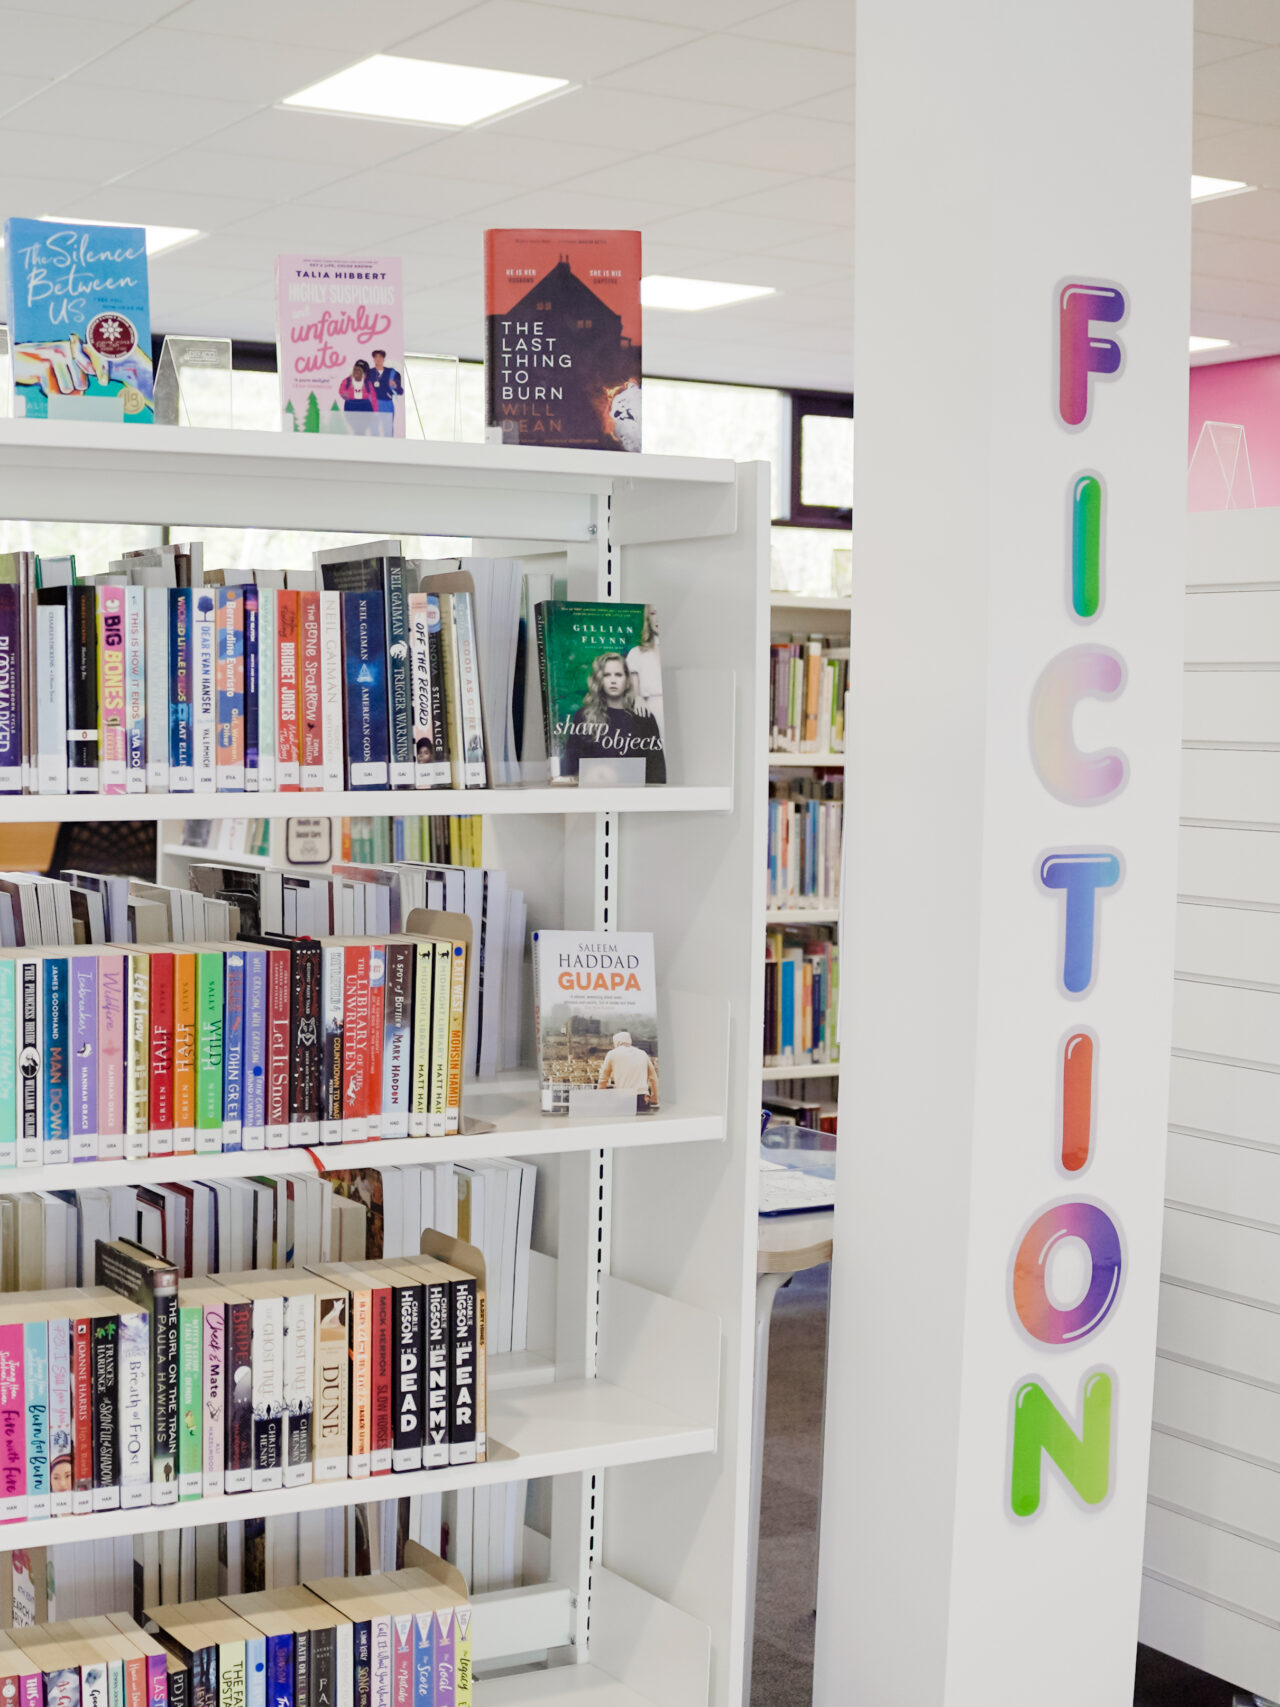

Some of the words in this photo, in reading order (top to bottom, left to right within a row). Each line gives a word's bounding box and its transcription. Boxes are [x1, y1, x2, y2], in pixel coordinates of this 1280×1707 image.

[18, 241, 51, 269] The
[46, 231, 144, 268] Silence
[26, 264, 138, 307] Between
[296, 270, 330, 279] TALIA
[335, 272, 386, 280] HIBBERT
[288, 283, 328, 303] HIGHLY
[329, 284, 394, 304] SUSPICIOUS
[290, 305, 391, 344] unfairly
[501, 322, 543, 335] THE
[294, 341, 346, 373] cute
[501, 354, 572, 368] THING
[502, 338, 557, 351] LAST
[501, 370, 528, 384] TO
[502, 386, 563, 400] BURN
[501, 403, 555, 417] WILL
[502, 420, 562, 433] DEAN
[391, 568, 402, 590] NEIL
[359, 600, 367, 621] NEIL
[392, 592, 403, 635] GAIMAN
[105, 615, 121, 646] BIG
[201, 626, 210, 648] DEAR
[226, 601, 236, 655] Bernardine
[360, 623, 368, 660] GAIMAN
[415, 623, 427, 645] OFF
[573, 624, 634, 634] GILLIAN
[581, 636, 626, 645] FLYNN
[202, 653, 210, 675] EVAN
[226, 658, 235, 697] Evaristo
[281, 642, 295, 684] BRIDGET
[417, 650, 428, 675] THE
[105, 650, 123, 709] BONES
[202, 678, 211, 714] HANSEN
[395, 667, 406, 710] TRIGGER
[281, 687, 296, 720] JONES
[361, 687, 370, 735] AMERICAN
[418, 678, 429, 726] RECORD
[396, 713, 409, 761] WARNING
[553, 715, 609, 743] sharp
[601, 729, 663, 755] objects
[363, 737, 371, 761] GODS
[1011, 282, 1125, 1518] FICTION
[559, 954, 640, 969] HADDAD
[578, 943, 618, 953] SALEEM
[557, 971, 641, 991] GUAPA
[345, 975, 356, 1072] UNWRITTEN
[356, 980, 367, 1050] LIBRARY
[272, 1019, 288, 1052] Let
[392, 1034, 403, 1061] MARK
[449, 1031, 460, 1070] MOHSIN
[272, 1056, 288, 1070] It
[271, 1074, 288, 1122] Snow
[391, 1066, 400, 1104] HADDON
[448, 1073, 459, 1106] HAMID
[168, 1299, 177, 1324] THE
[401, 1291, 414, 1344] HIGSON
[429, 1287, 441, 1340] HIGSON
[456, 1285, 467, 1337] HIGSON
[157, 1315, 167, 1363] PAULA
[168, 1330, 177, 1360] GIRL
[169, 1364, 177, 1383] ON
[456, 1347, 472, 1425] FEAR
[157, 1373, 167, 1443] HAWKINS
[168, 1388, 177, 1413] THE
[322, 1366, 340, 1438] DUNE
[400, 1354, 418, 1432] DEAD
[430, 1351, 446, 1445] ENEMY
[168, 1417, 177, 1453] TRAIN
[233, 1661, 243, 1682] THE
